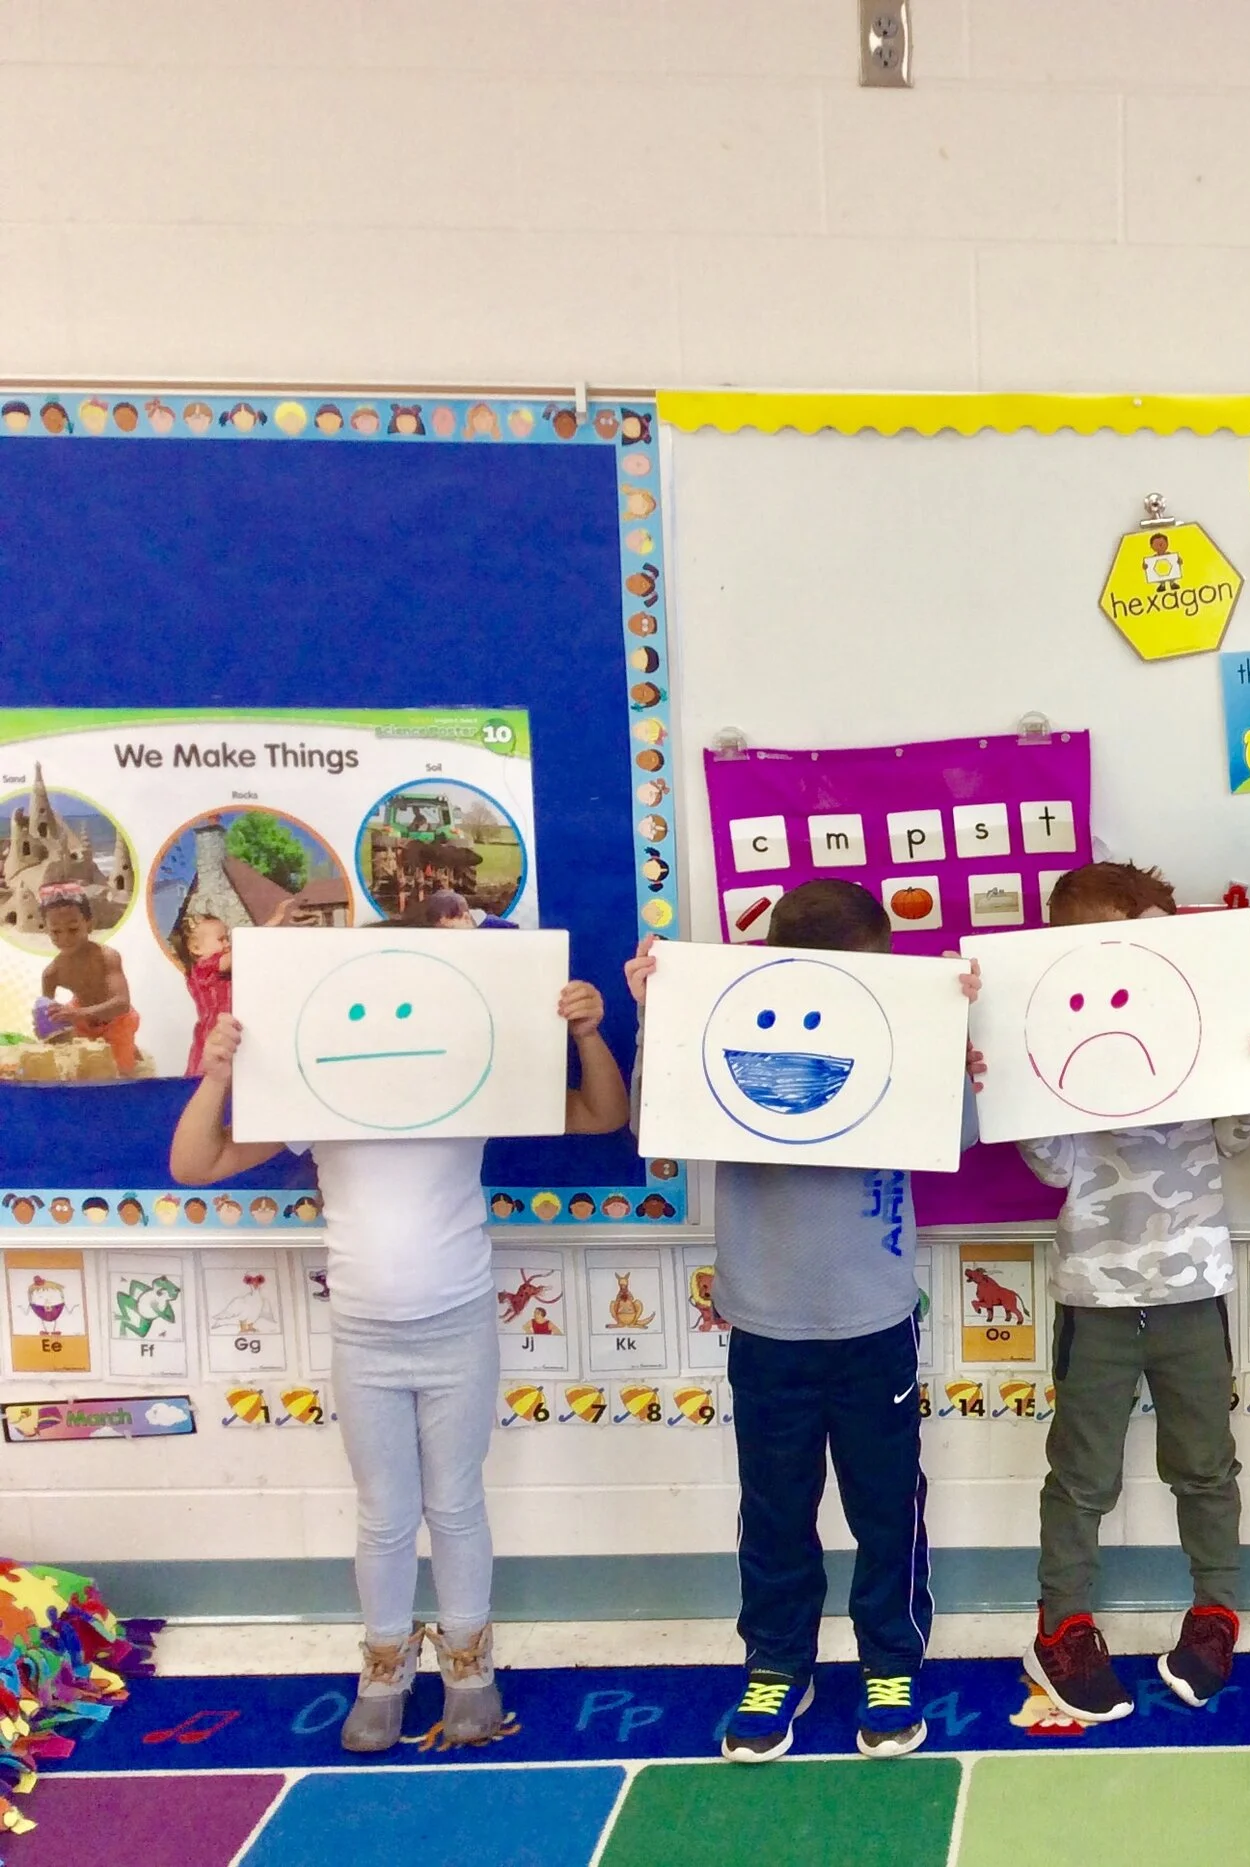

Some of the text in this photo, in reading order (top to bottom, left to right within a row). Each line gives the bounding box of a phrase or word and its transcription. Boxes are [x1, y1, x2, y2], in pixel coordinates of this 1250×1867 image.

[1110, 580, 1233, 619] hexagon
[483, 726, 512, 743] 10
[114, 743, 359, 774] We Make Things
[426, 763, 442, 772] Soil
[2, 775, 26, 783] Sand
[232, 791, 258, 800] Rocks
[1038, 806, 1056, 836] t
[975, 823, 989, 840] s
[753, 836, 769, 852] c
[826, 832, 849, 850] m
[907, 829, 926, 858] p
[986, 1328, 1010, 1341] Oo
[42, 1338, 62, 1353] Ee
[141, 1344, 155, 1357] Ff
[234, 1338, 261, 1353] Gg
[522, 1338, 535, 1351] Jj
[616, 1338, 637, 1350] Kk
[261, 1406, 270, 1423] 1
[309, 1405, 324, 1425] 2
[534, 1403, 550, 1422] 6
[592, 1404, 607, 1423] 7
[647, 1402, 662, 1422] 8
[699, 1406, 715, 1425] 9
[920, 1398, 932, 1417] 3
[959, 1398, 985, 1417] 14
[1014, 1398, 1035, 1417] 15
[66, 1408, 132, 1428] March
[575, 1689, 663, 1742] Pp
